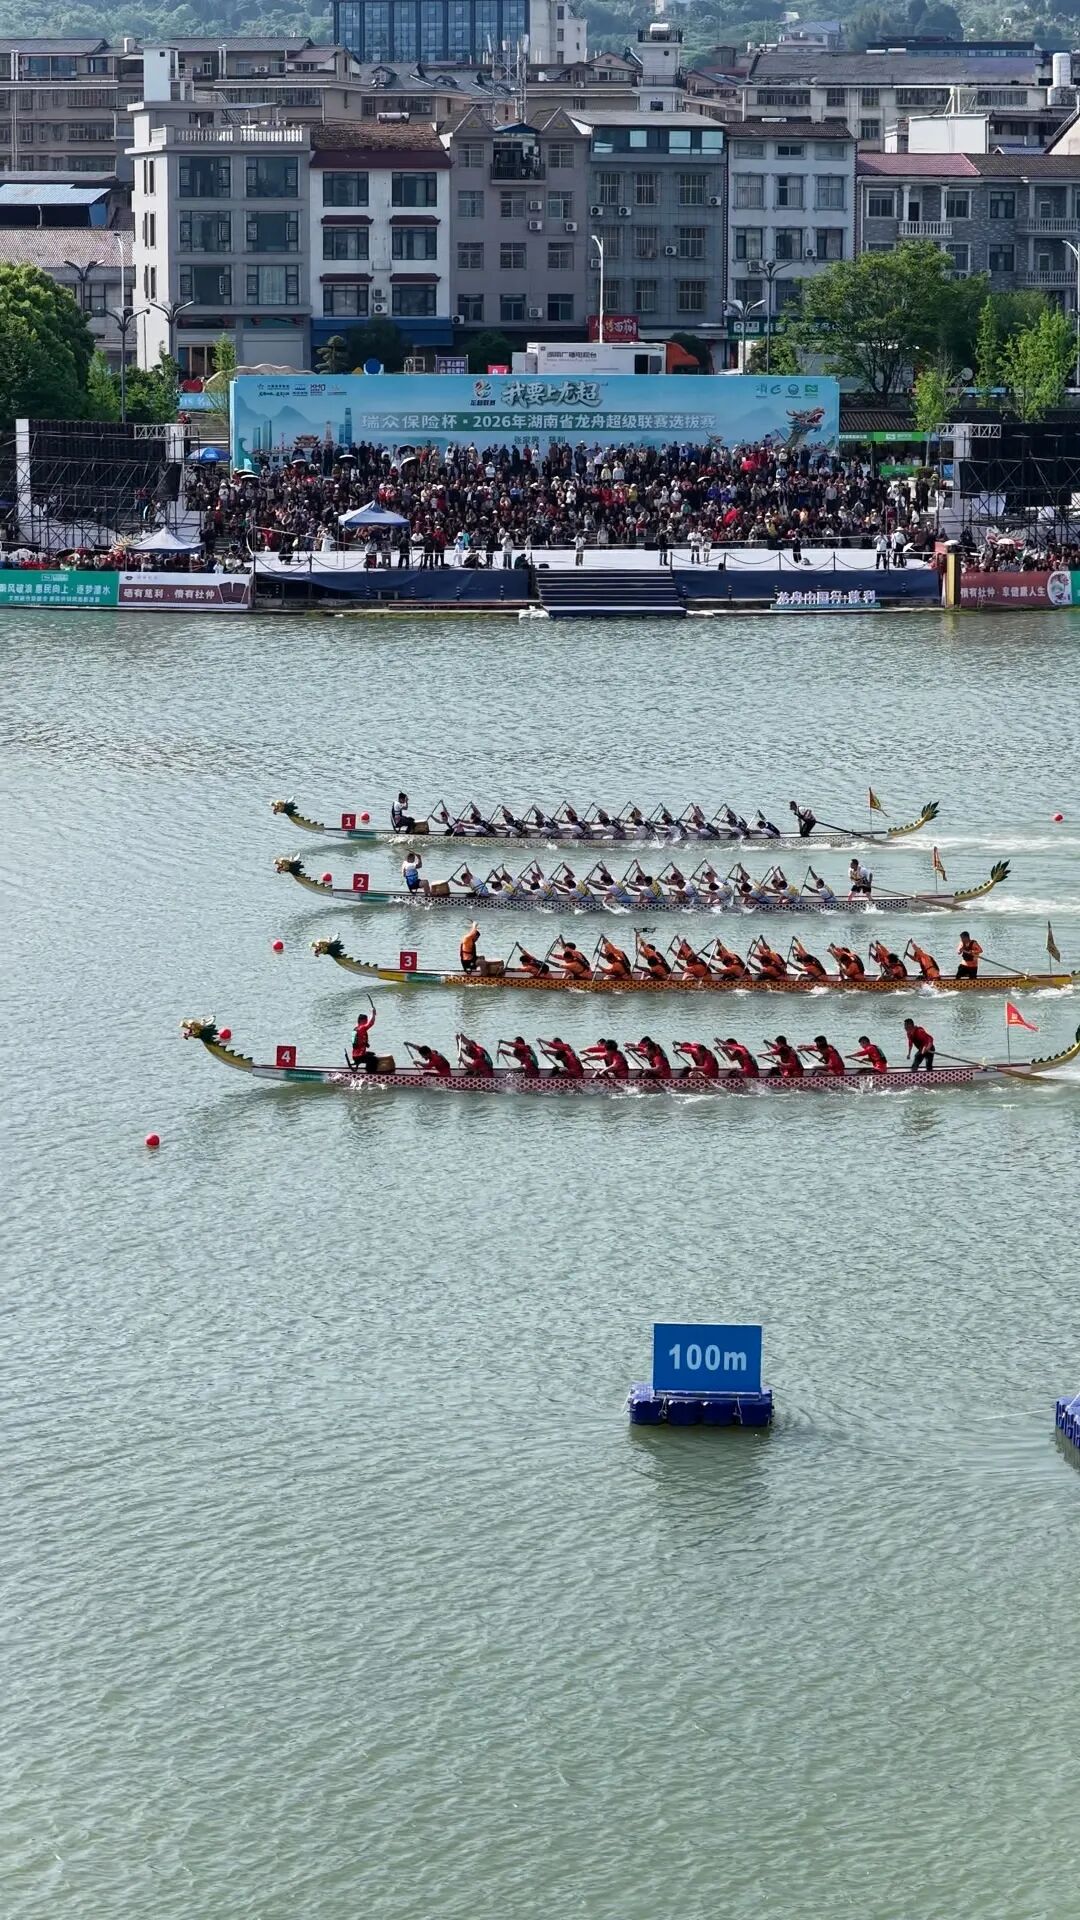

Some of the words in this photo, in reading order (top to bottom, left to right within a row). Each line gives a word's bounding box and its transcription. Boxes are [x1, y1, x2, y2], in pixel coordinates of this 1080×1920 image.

[546, 351, 597, 359] 湖南广播电视台
[345, 817, 352, 827] 1
[357, 877, 365, 888] 2
[404, 955, 413, 967] 3
[281, 1050, 291, 1063] 4
[668, 1343, 747, 1371] 100m
